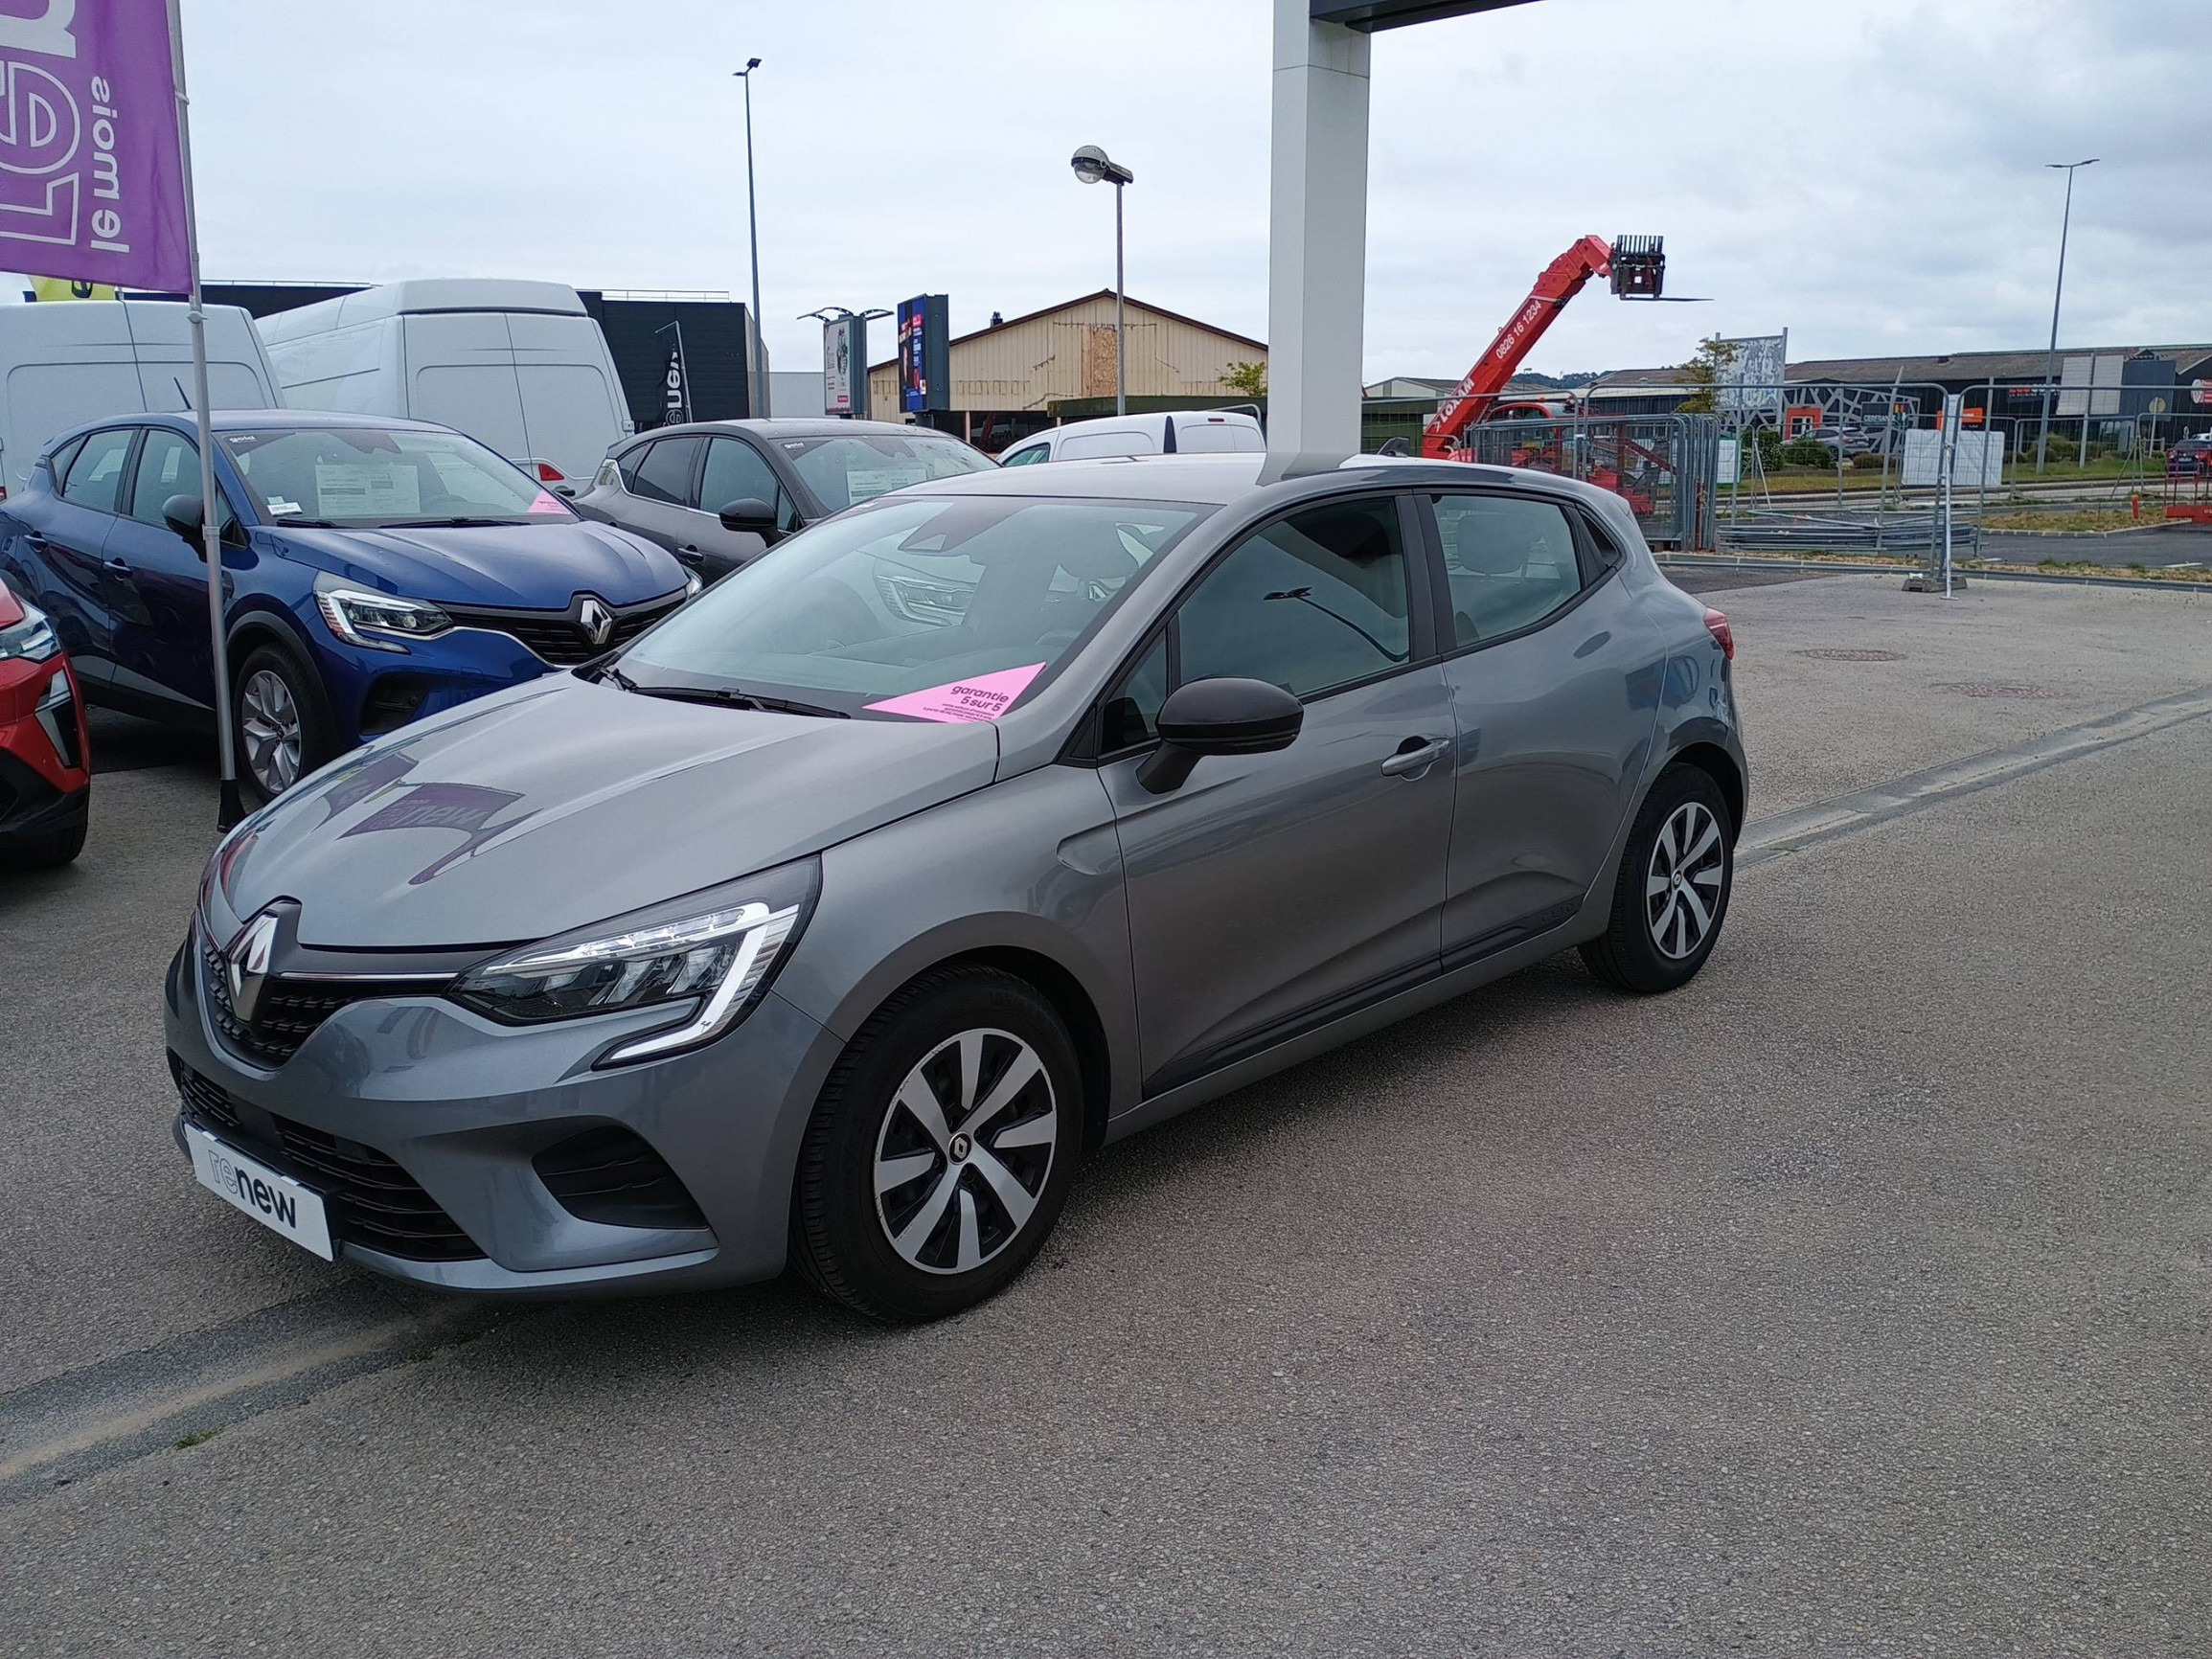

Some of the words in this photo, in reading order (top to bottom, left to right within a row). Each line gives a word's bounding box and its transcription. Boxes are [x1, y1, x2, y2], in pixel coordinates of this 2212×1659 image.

[1495, 333, 1516, 359] 0826
[1513, 321, 1525, 337] 16
[1522, 300, 1542, 325] 1234
[950, 684, 1010, 703] garantie
[960, 695, 972, 705] 5
[971, 698, 992, 710] sur
[992, 702, 1003, 712] 5
[1542, 903, 1573, 921] CLIO
[207, 1148, 297, 1230] renew
